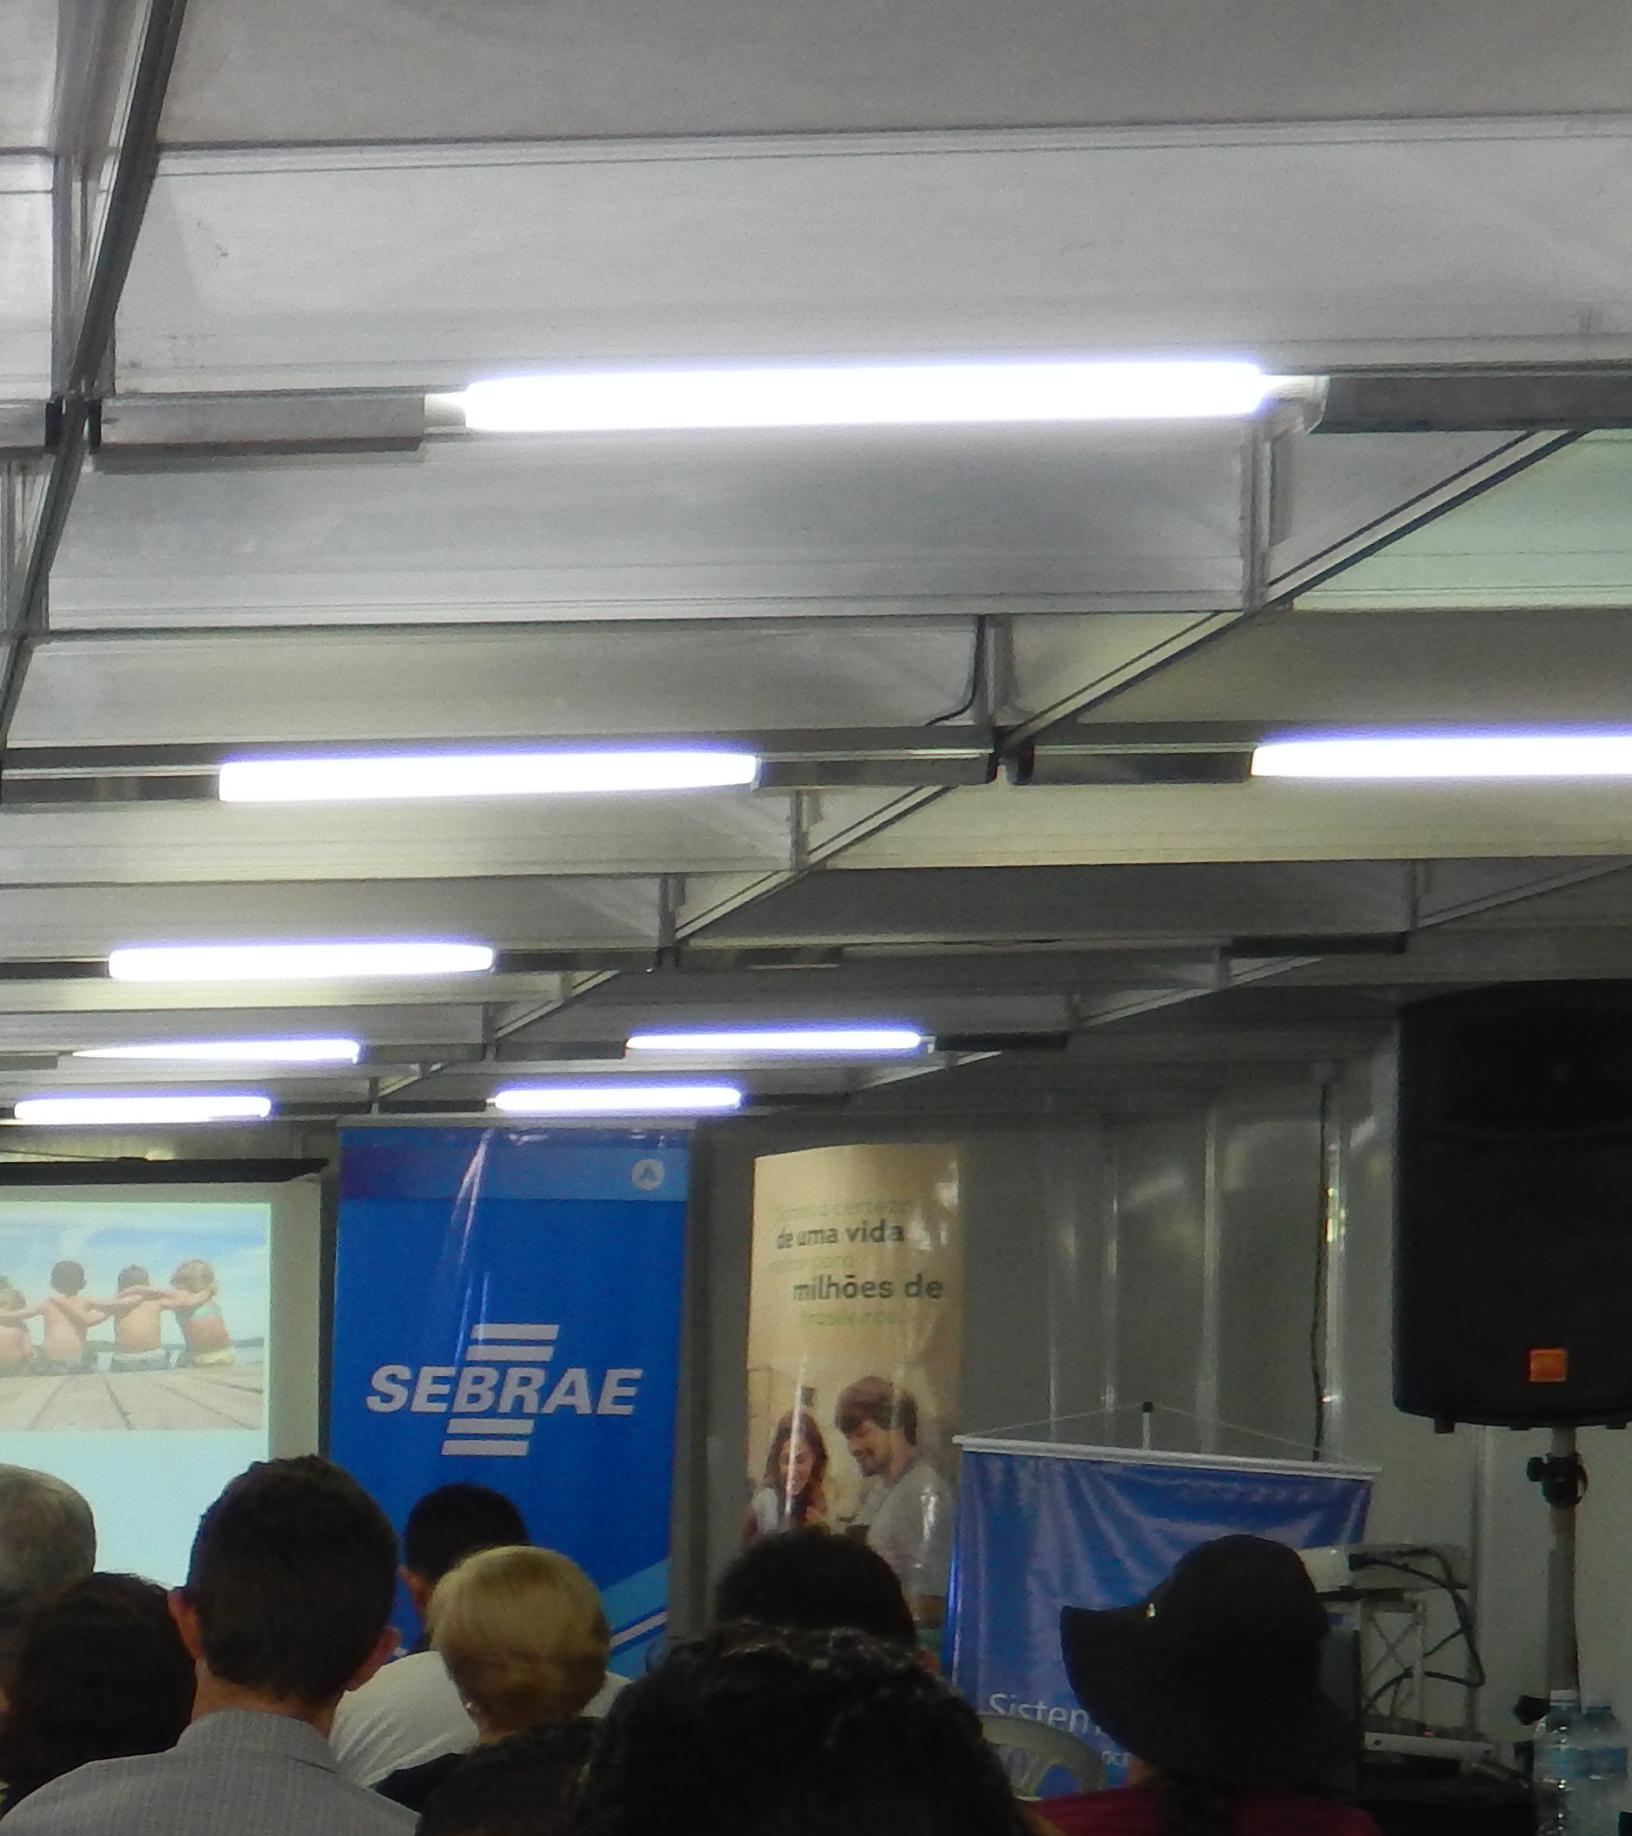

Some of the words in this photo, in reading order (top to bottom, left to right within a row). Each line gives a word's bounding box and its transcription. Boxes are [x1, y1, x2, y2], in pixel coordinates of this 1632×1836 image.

[776, 1227, 794, 1250] de
[798, 1228, 838, 1246] uma
[845, 1219, 905, 1243] vida
[792, 1274, 894, 1301] milhões
[904, 1272, 944, 1300] de
[365, 1364, 643, 1415] SEBRAE
